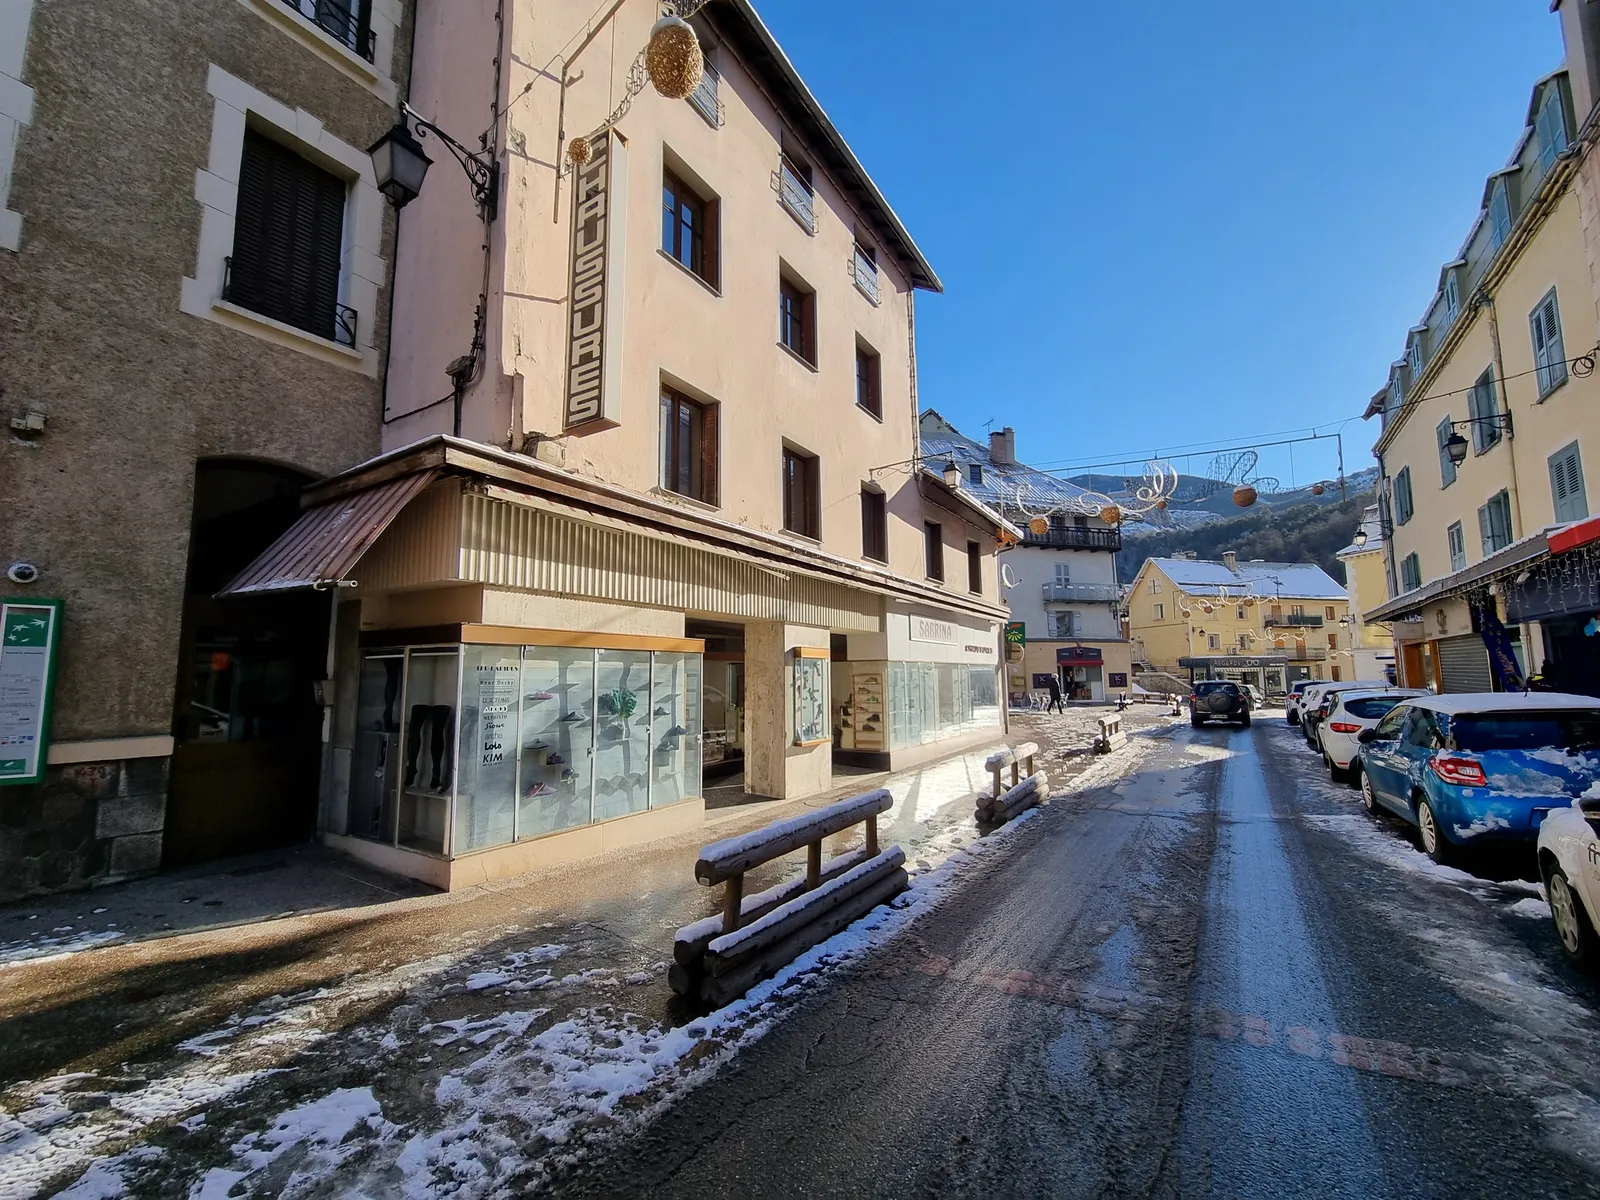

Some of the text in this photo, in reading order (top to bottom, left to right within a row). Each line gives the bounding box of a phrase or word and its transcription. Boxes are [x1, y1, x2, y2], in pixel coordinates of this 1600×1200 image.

[568, 136, 608, 423] CHAUSSURES
[919, 620, 952, 641] SABRINA
[485, 741, 502, 751] Lois
[482, 753, 503, 763] KIM
